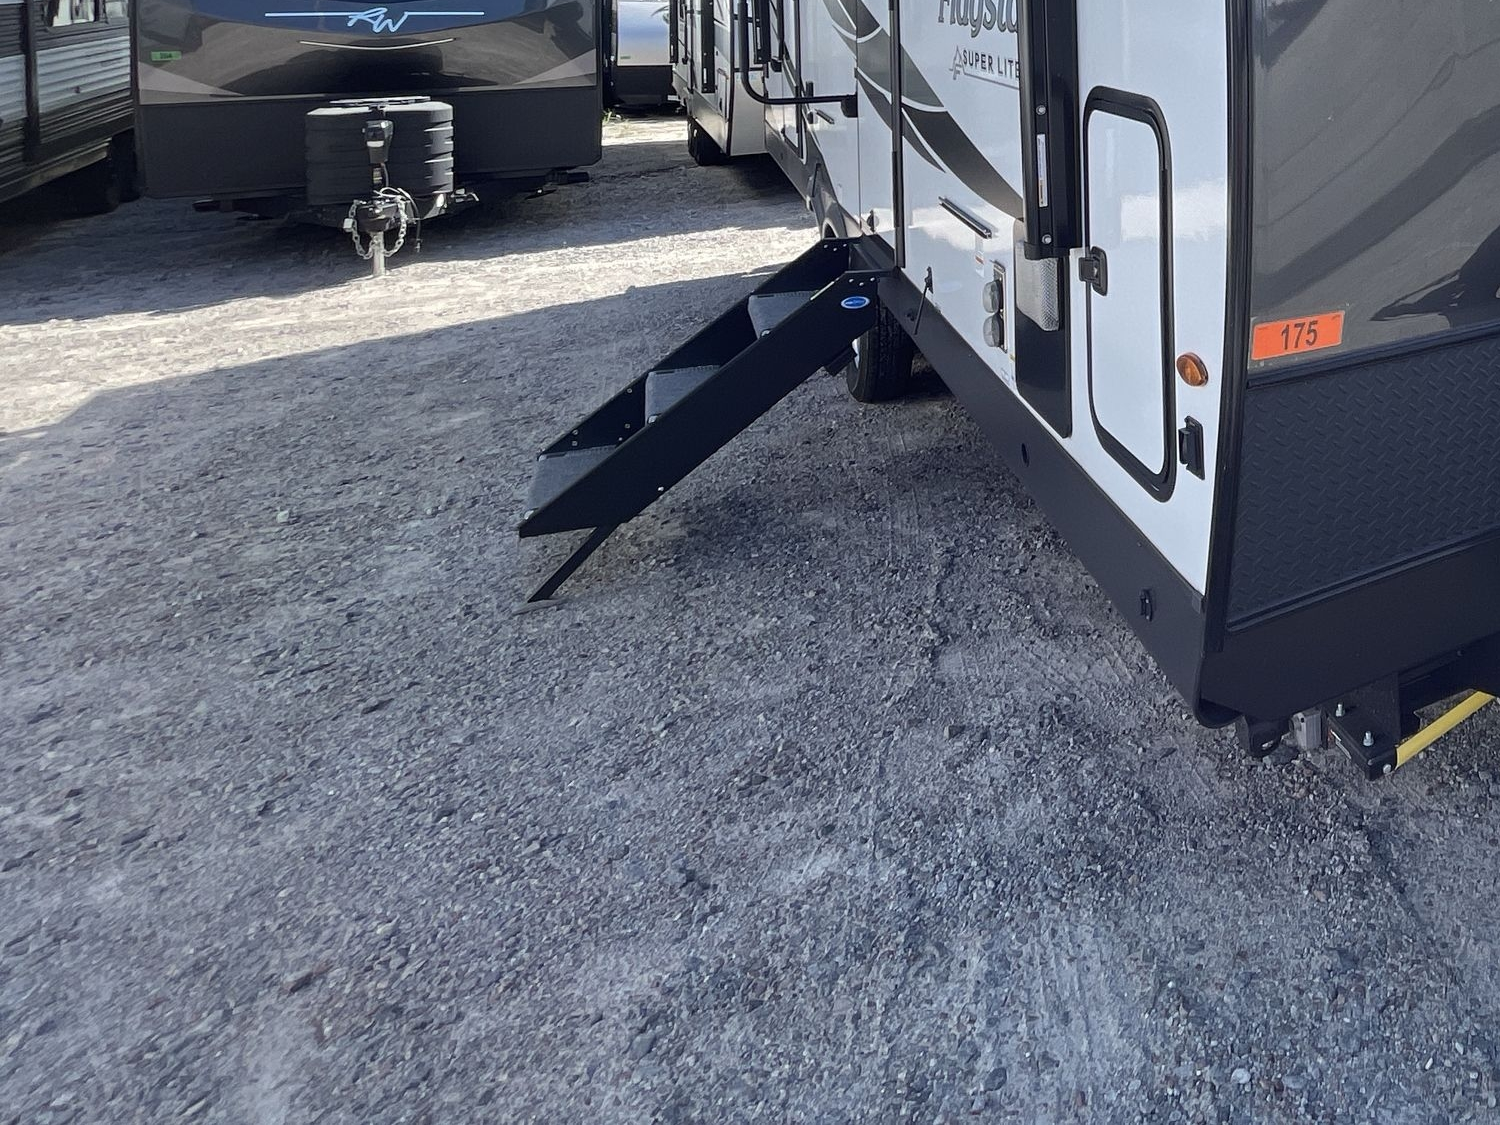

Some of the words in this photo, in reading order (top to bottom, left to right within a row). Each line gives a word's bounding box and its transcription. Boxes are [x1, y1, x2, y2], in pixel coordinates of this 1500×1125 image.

[962, 49, 993, 73] SUPER
[997, 56, 1020, 79] LITE
[1281, 320, 1319, 351] 175
